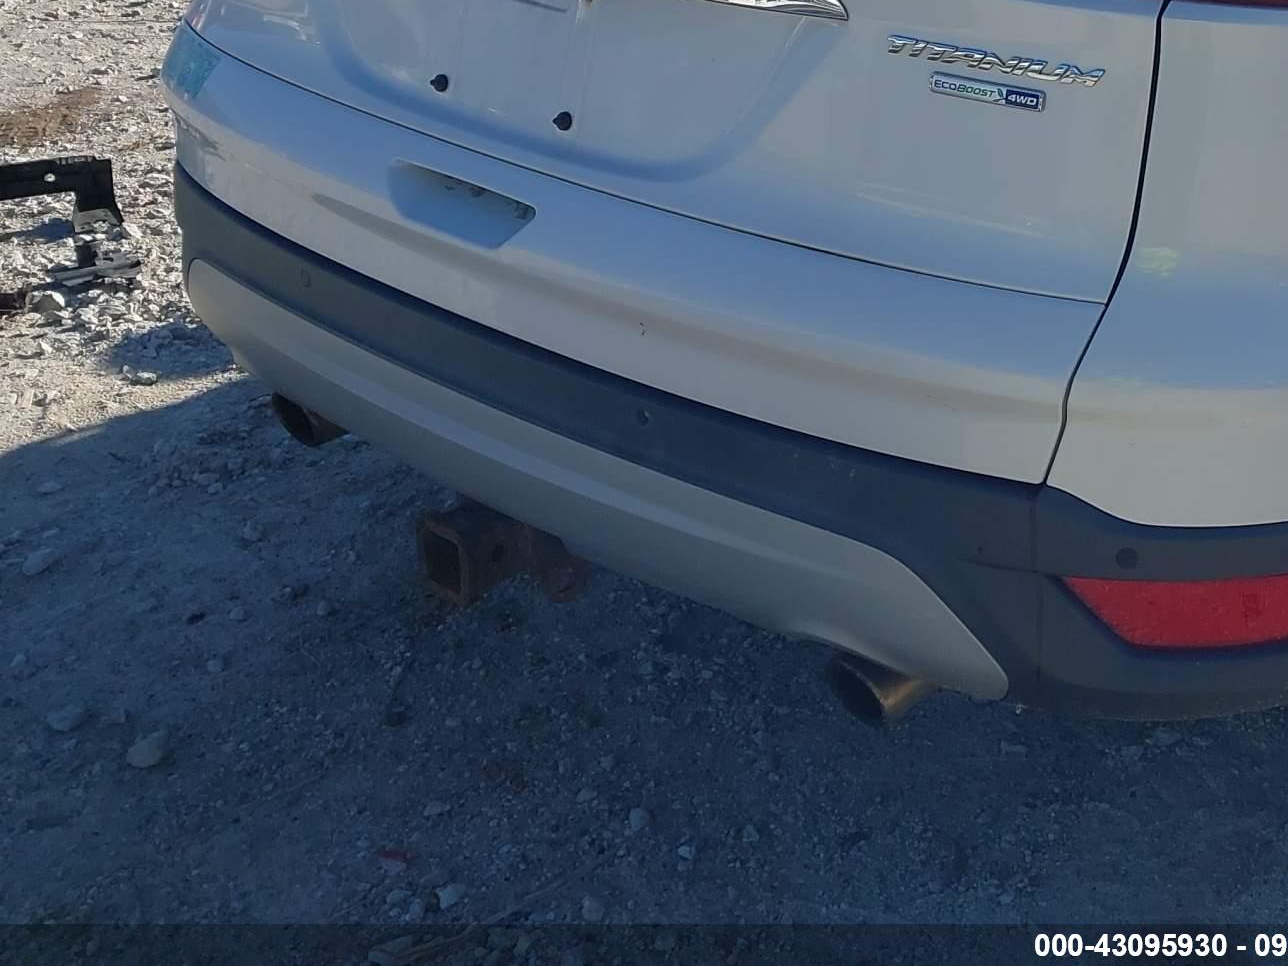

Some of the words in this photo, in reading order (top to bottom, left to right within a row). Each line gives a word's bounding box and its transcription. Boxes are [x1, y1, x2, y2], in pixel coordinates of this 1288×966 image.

[887, 34, 1106, 87] TITANIUM
[934, 79, 997, 99] ECOBOOST
[1007, 92, 1038, 107] 4WD
